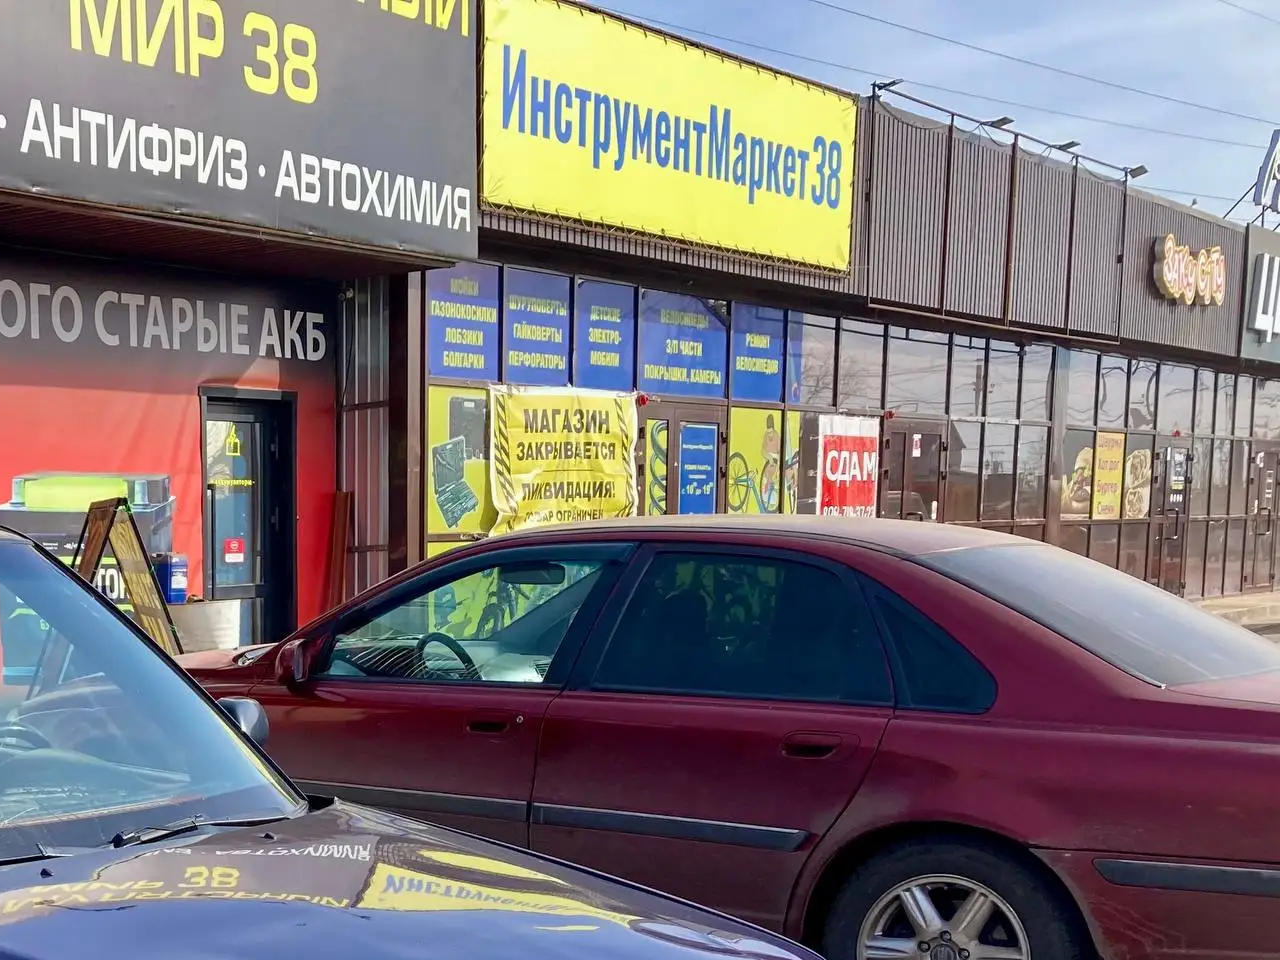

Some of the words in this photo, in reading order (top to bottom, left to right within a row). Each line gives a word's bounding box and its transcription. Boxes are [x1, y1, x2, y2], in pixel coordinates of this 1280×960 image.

[70, 0, 225, 77] МИР
[243, 12, 318, 104] 38
[21, 98, 247, 190] АНТИФРИЗ
[274, 149, 471, 232] АВТОХИМИЯ
[450, 277, 479, 297] МОЙКИ
[509, 295, 567, 316] ШУРУПОВЕРТЫ
[1254, 252, 1280, 343] Ц
[431, 300, 497, 323] ГАЗОНОКОСИЛКИ
[590, 305, 621, 322] ДЕТСКИЕ
[94, 290, 250, 355] СТАРЫЕ
[259, 308, 326, 362] АКБ
[513, 321, 563, 343] ГАЙКОВЕРТЫ
[445, 327, 483, 346] ЛОБЗИКИ
[588, 328, 622, 345] ЭЛЕКТРО-
[746, 333, 770, 349] РЕМОНТ
[590, 350, 619, 367] МОБИЛИ
[679, 341, 703, 357] ЧАСТИ
[443, 350, 484, 369] БОЛГАРКИ
[509, 350, 566, 370] ПЕРФОРАТОРЫ
[735, 356, 779, 375] ВЕЛОСИПЕДОВ
[690, 368, 721, 385] КАМЕРЫ
[523, 408, 610, 434] МАГАЗИН
[516, 441, 616, 461] ЗАКРЫВАЕТСЯ
[825, 449, 877, 487] СДАМ
[522, 480, 616, 502] ЛИКВИДАЦИЯ!
[556, 508, 604, 522] ОГРАНИЧЕН
